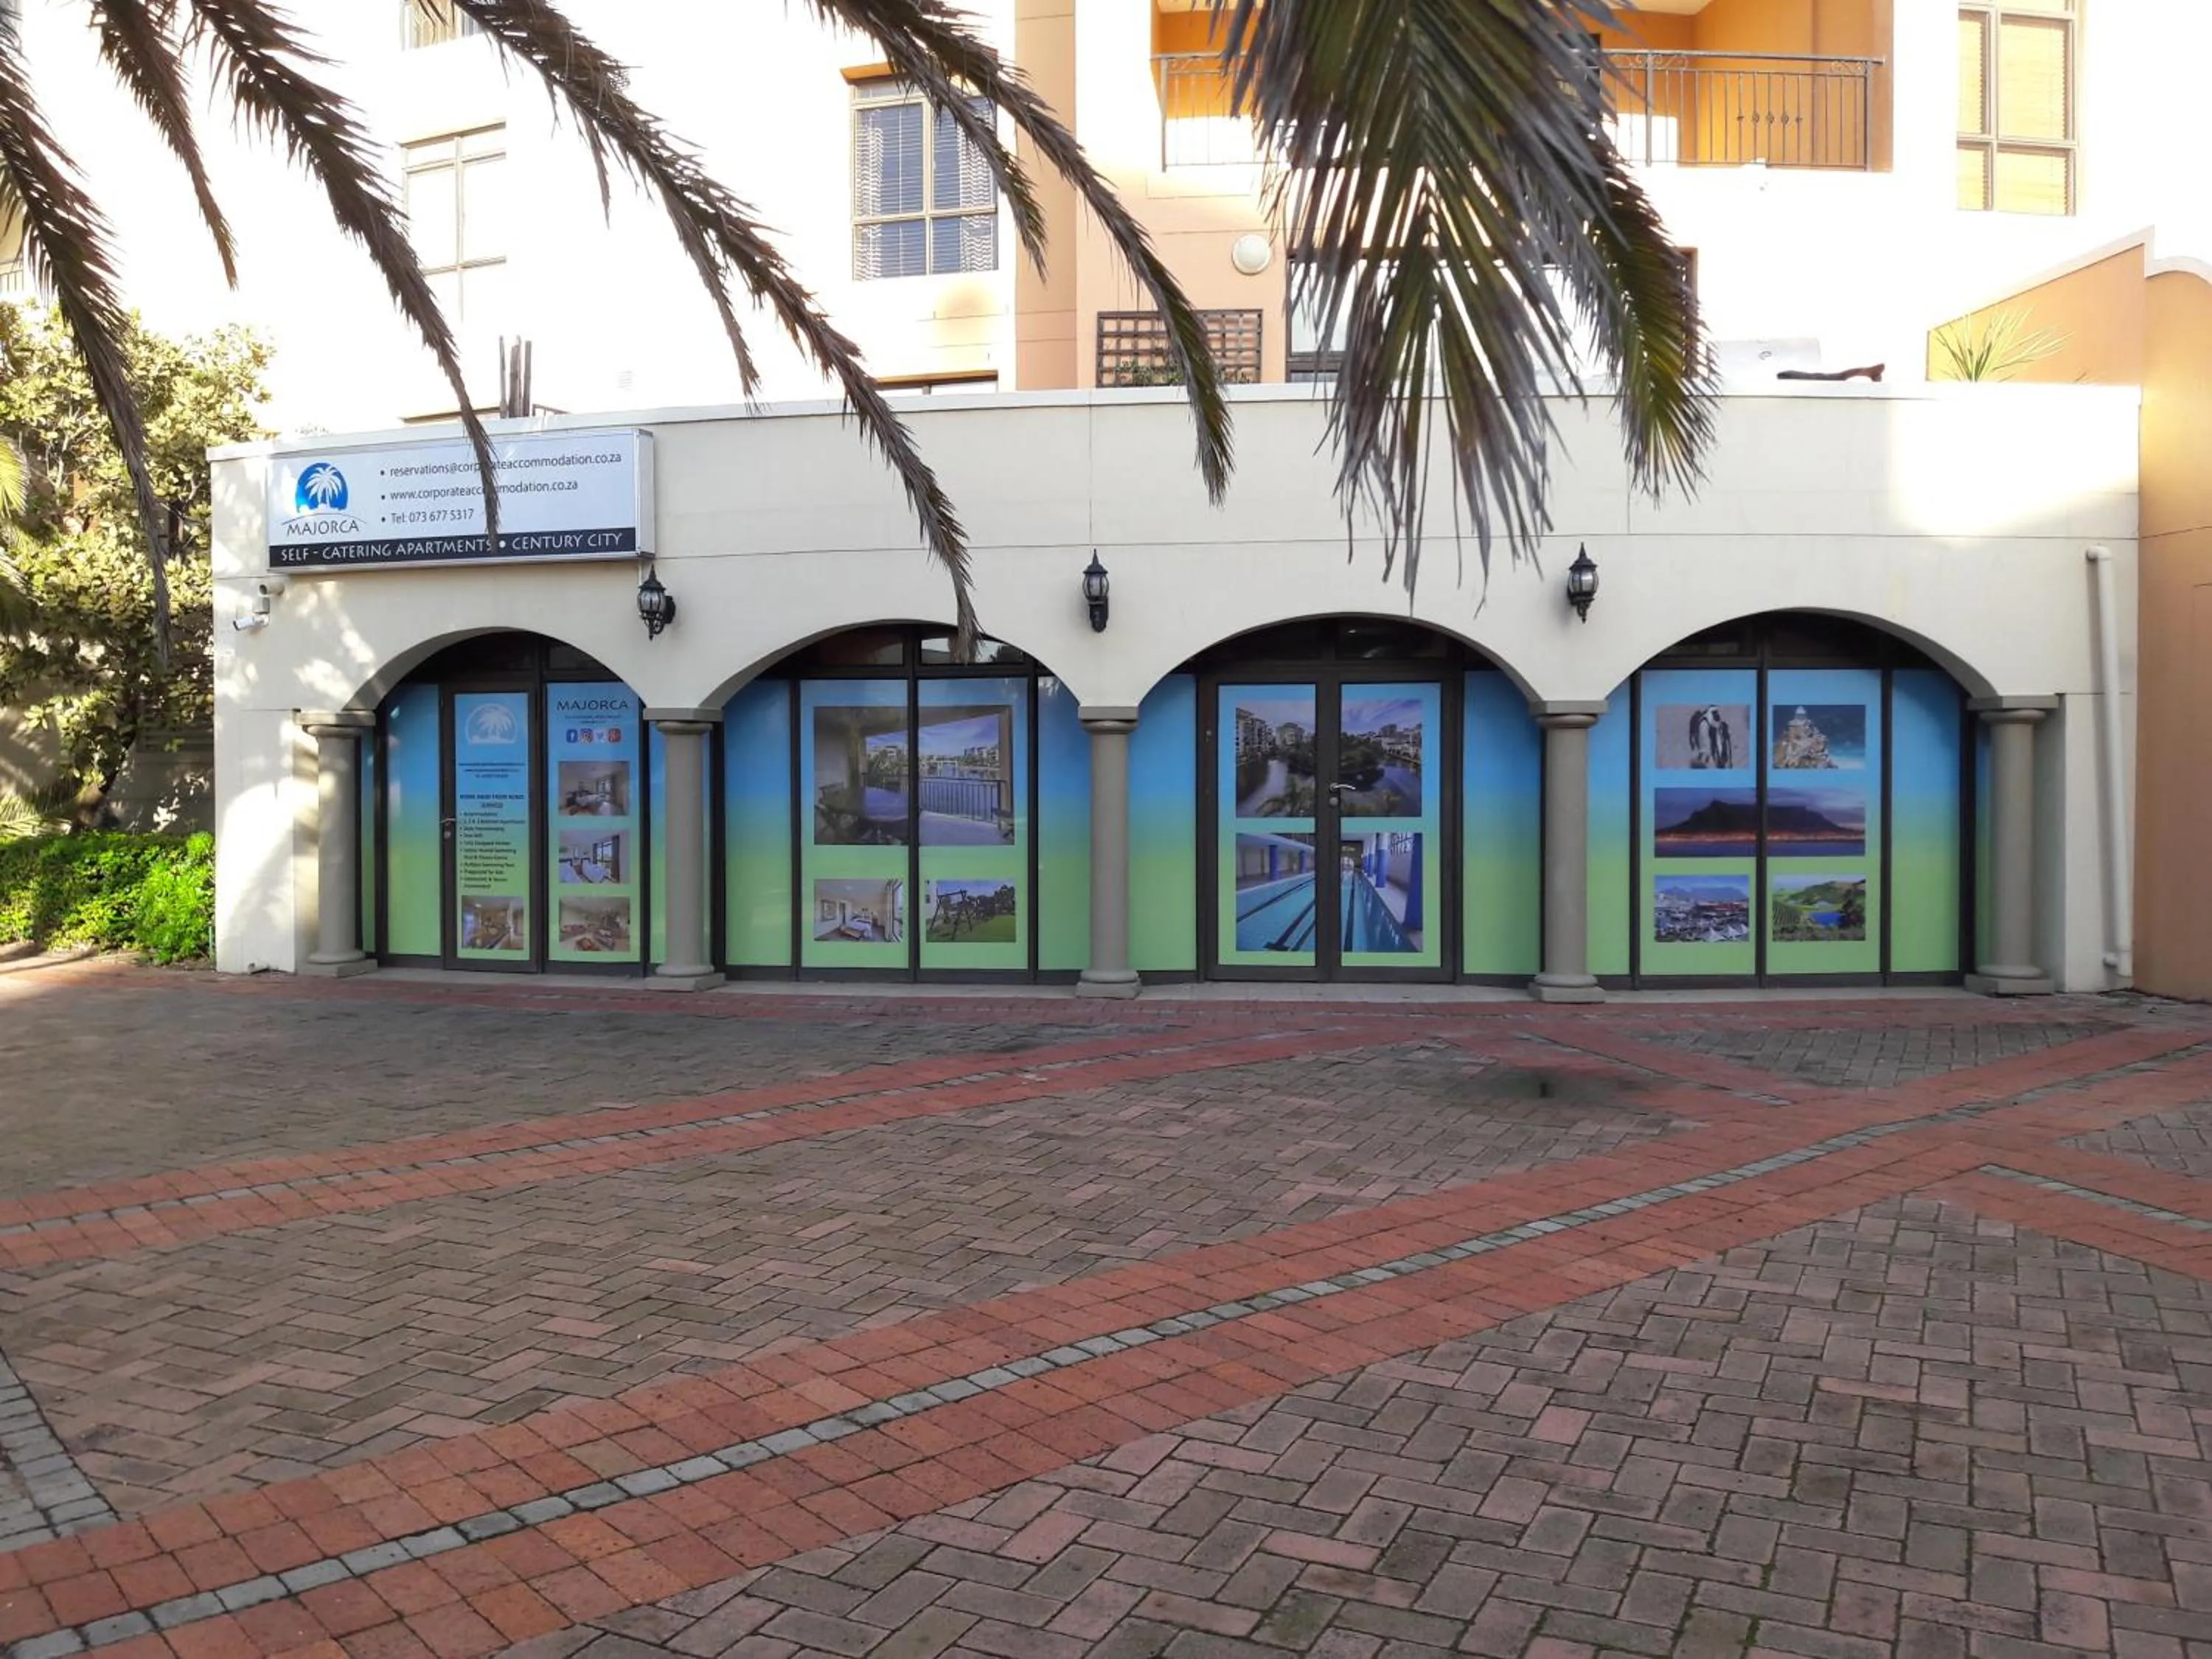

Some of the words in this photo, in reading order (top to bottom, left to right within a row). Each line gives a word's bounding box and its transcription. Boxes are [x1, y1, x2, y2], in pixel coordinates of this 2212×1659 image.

[390, 453, 622, 477] reservations@corpteaccommodation.co.za
[390, 479, 579, 500] www.corporateaccmodation.co.za
[409, 511, 427, 523] 073
[430, 509, 448, 521] 677
[450, 508, 474, 521] 5317
[287, 519, 360, 537] MAJORCA
[281, 548, 309, 562] SELF
[322, 543, 392, 560] CATERING
[395, 538, 492, 555] APARTMENTS
[512, 534, 584, 551] CENTURY
[588, 532, 623, 547] CITY
[557, 699, 628, 711] MAJORCA
